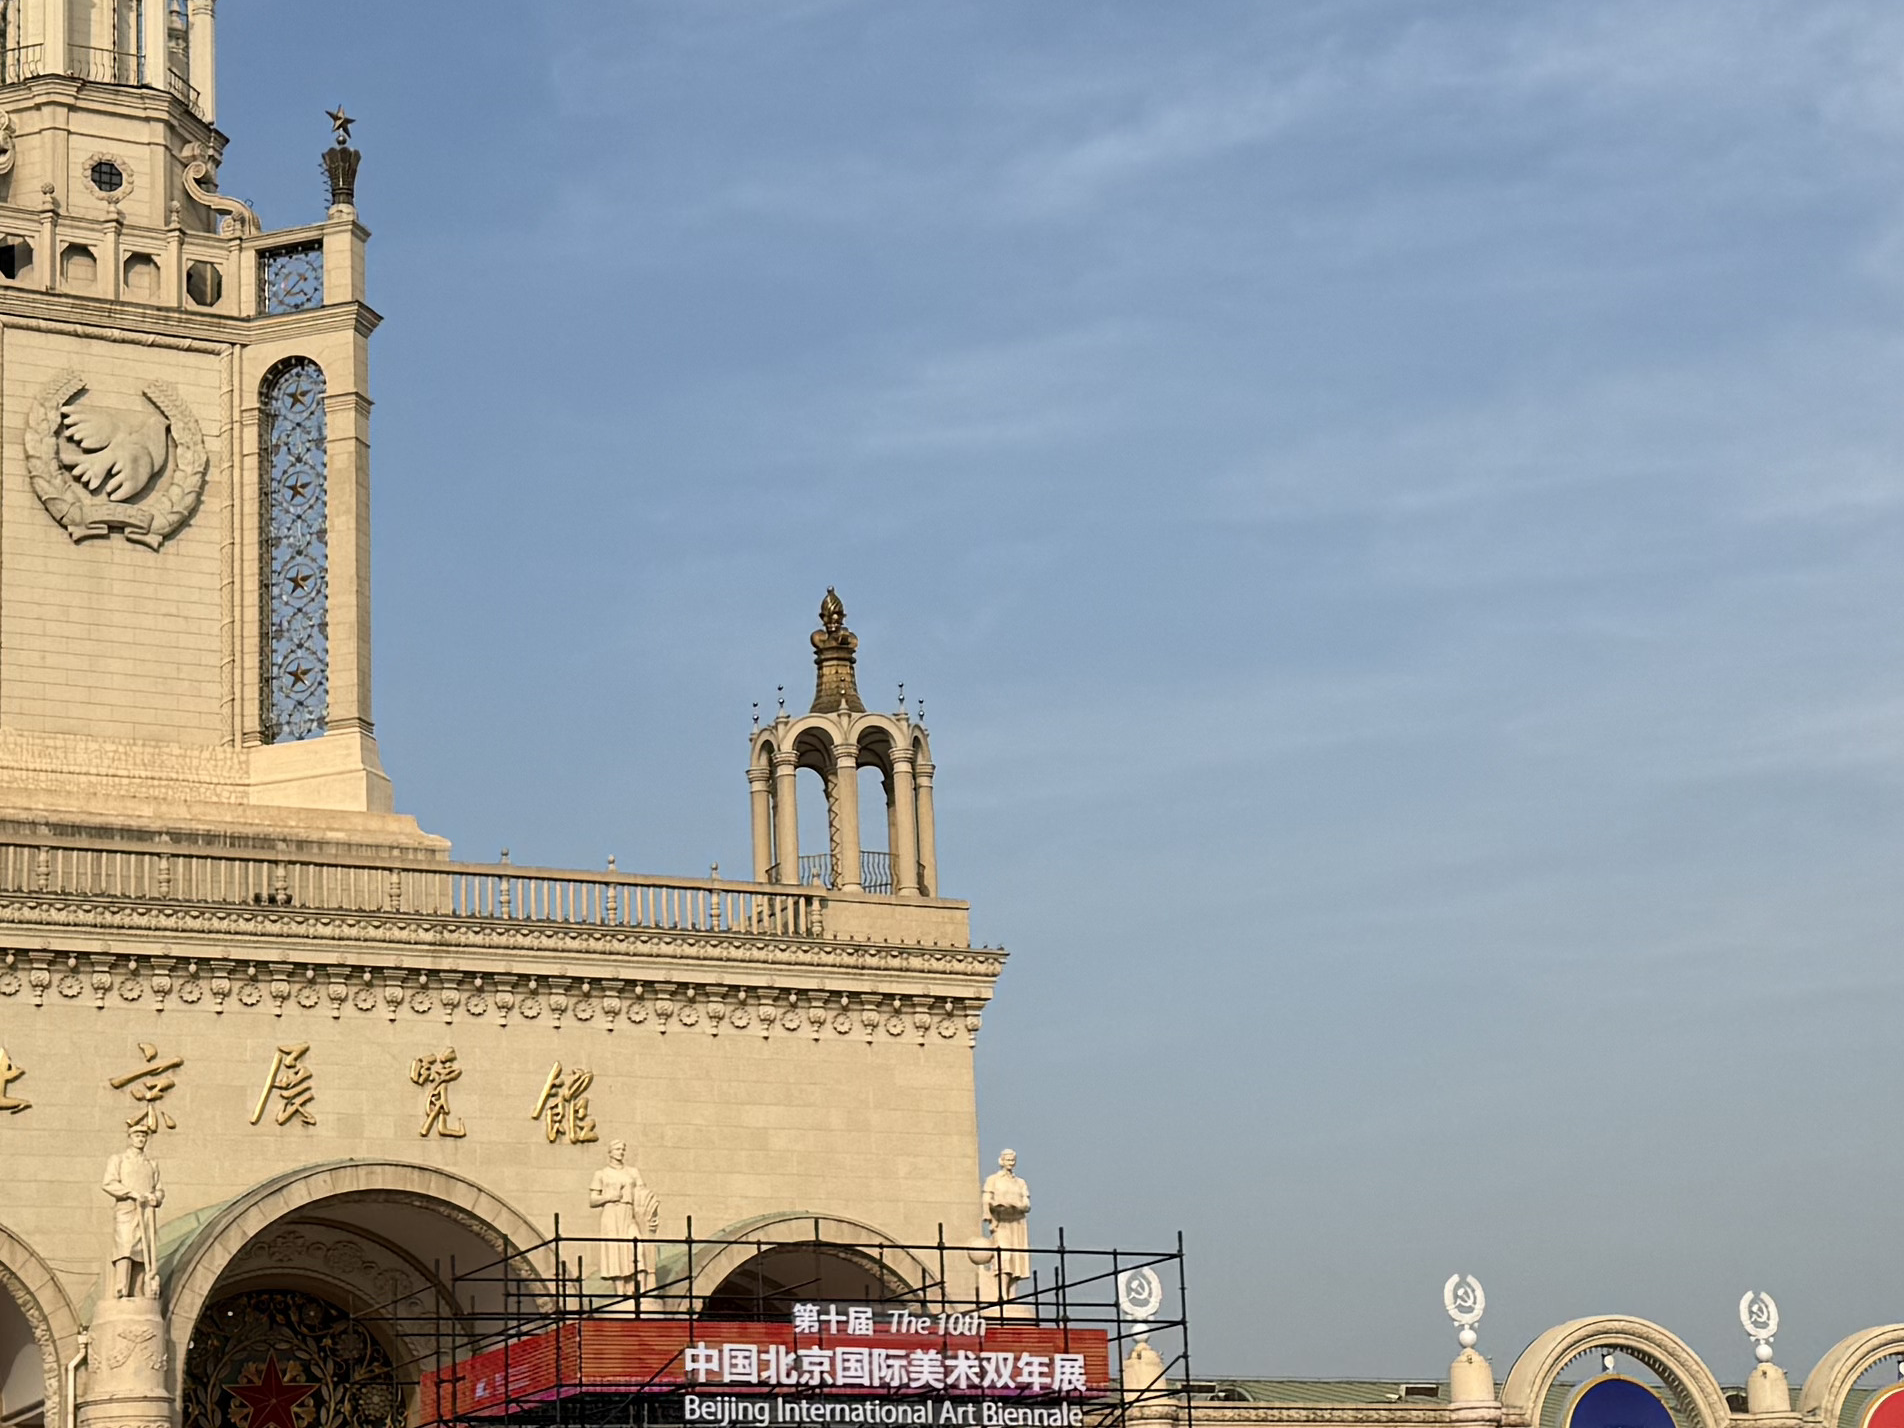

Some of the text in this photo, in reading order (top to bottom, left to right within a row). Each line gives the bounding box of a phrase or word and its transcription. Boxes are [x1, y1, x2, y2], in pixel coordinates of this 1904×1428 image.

[793, 1303, 987, 1336] 第十届 The 10th
[684, 1342, 1087, 1392] 中国北京国际美术双年展
[685, 1395, 1084, 1427] Beijing International Art Biennale
